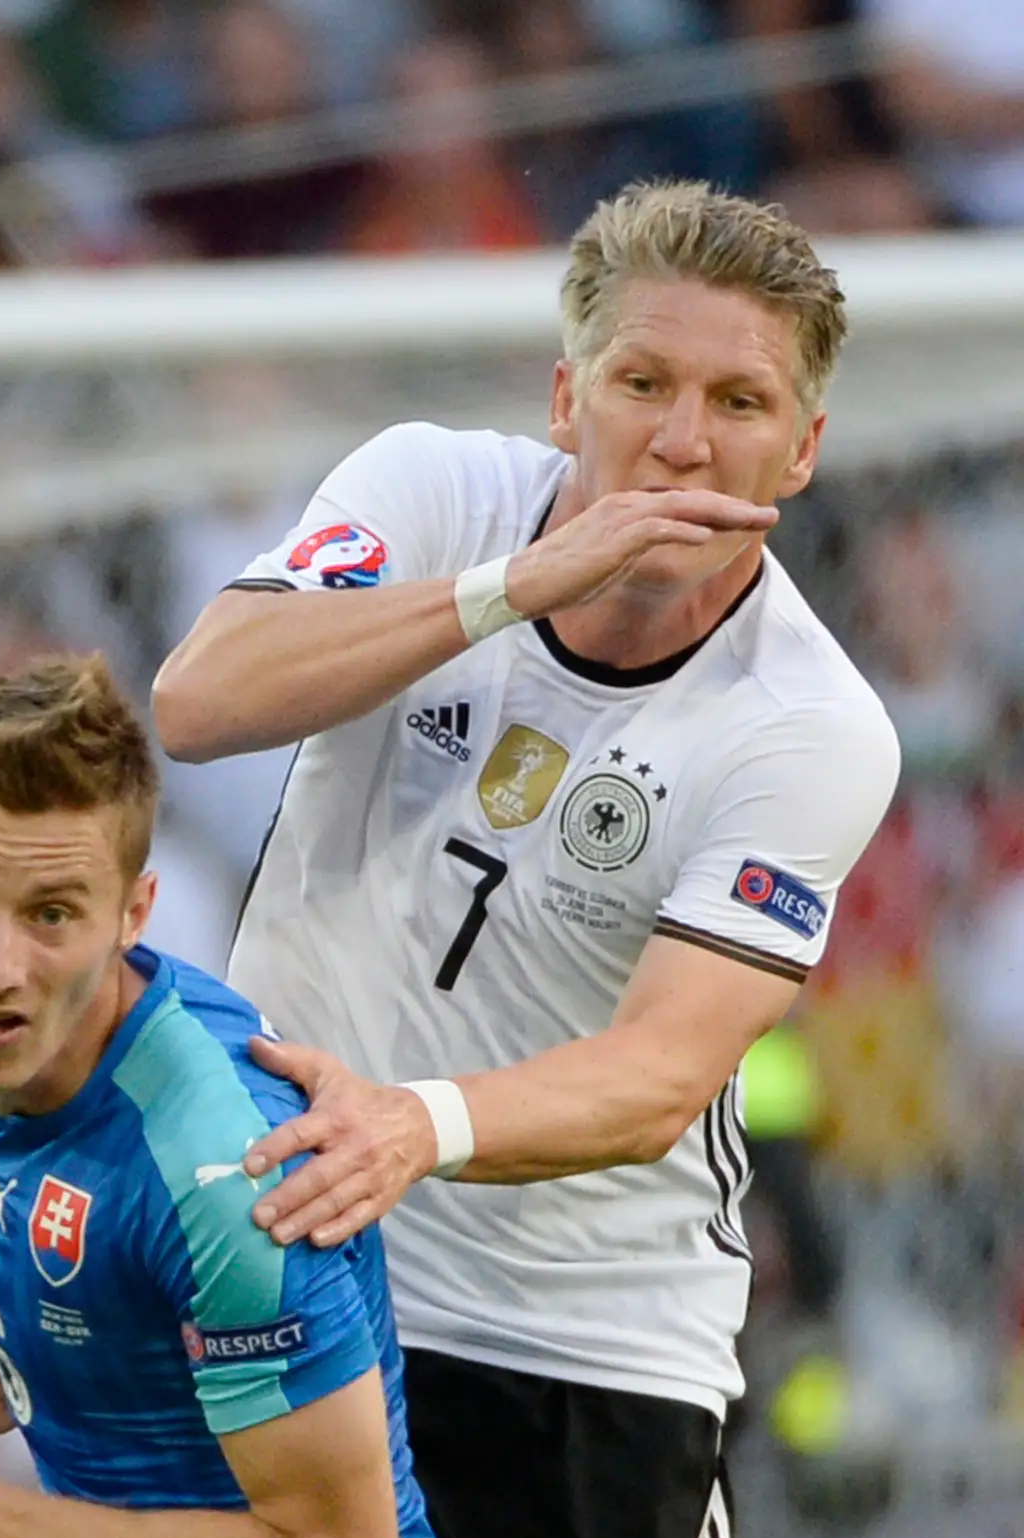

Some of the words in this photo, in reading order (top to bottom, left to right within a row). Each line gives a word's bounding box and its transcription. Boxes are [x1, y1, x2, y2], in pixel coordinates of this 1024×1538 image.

[406, 713, 471, 762] adidas
[434, 837, 508, 992] 7
[204, 1322, 304, 1357] RESPECT
